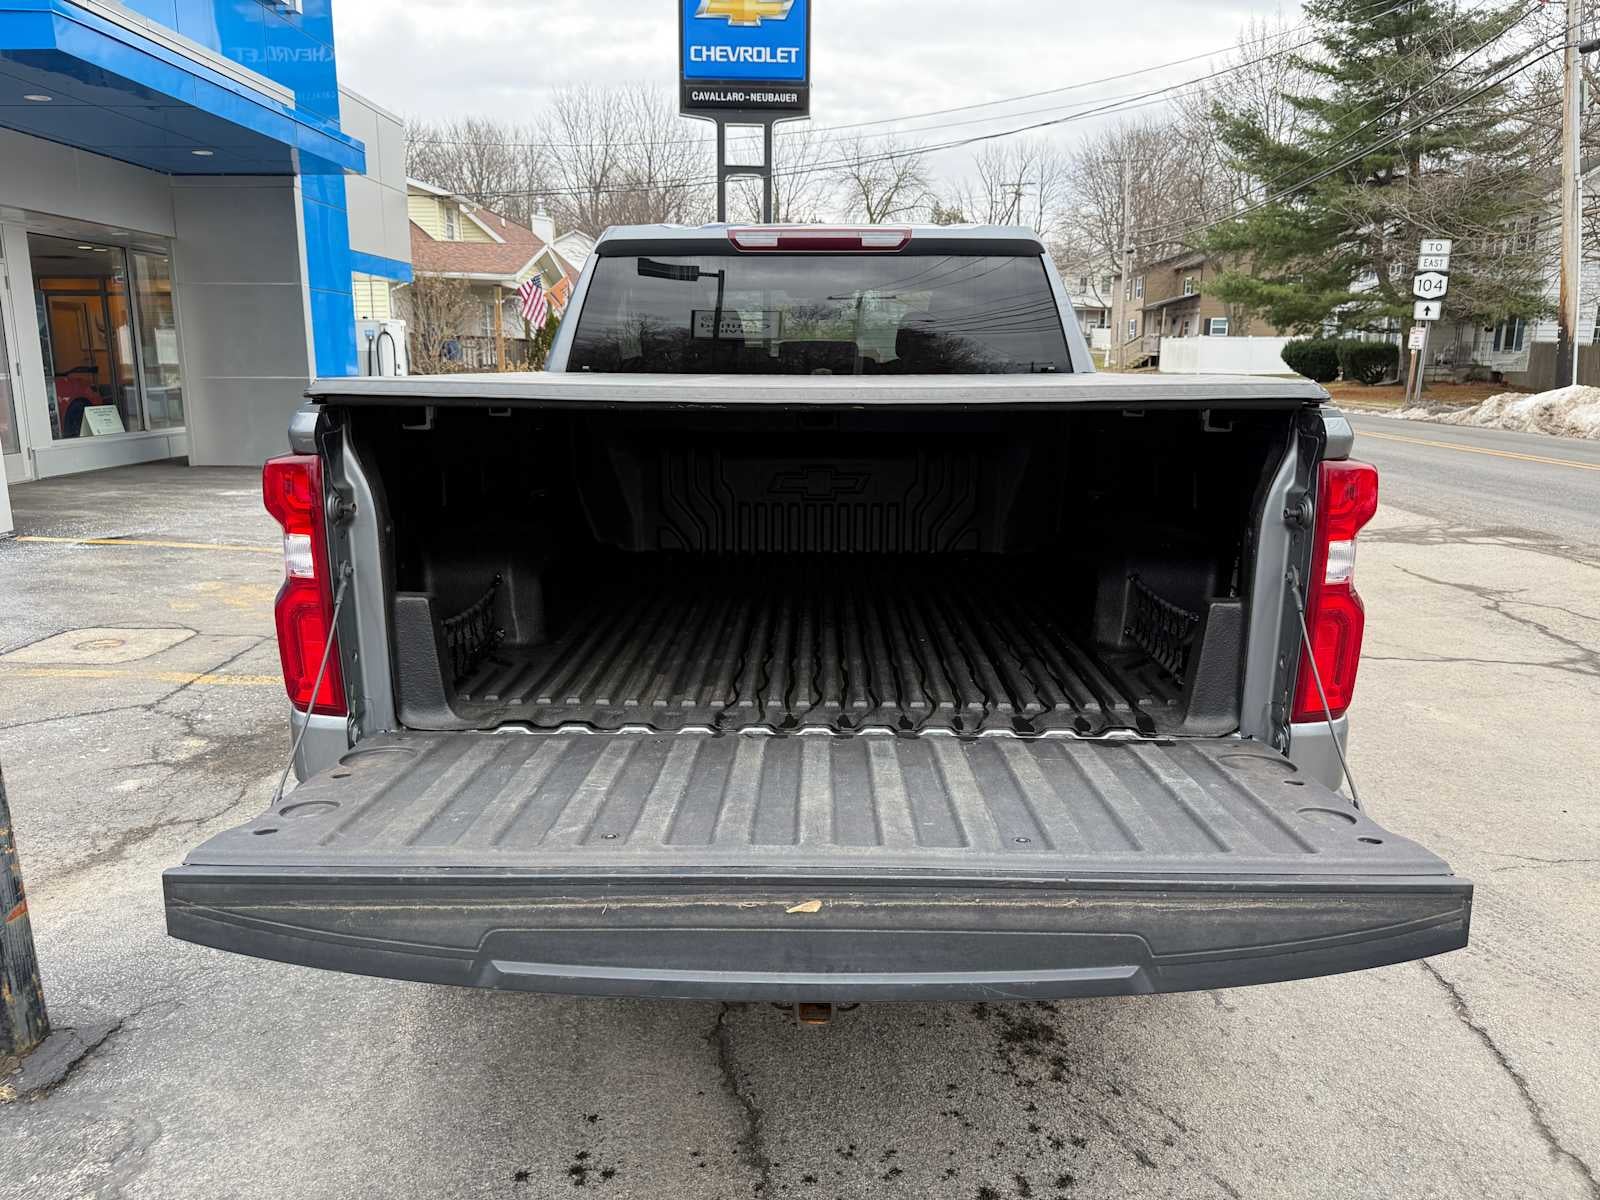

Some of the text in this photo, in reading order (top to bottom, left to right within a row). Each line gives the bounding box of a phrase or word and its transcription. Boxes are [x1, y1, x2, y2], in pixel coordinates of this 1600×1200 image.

[690, 45, 799, 63] CHEVROLET
[692, 91, 798, 103] CAVALLARO-NEUBAUER
[1429, 243, 1443, 252] TO
[1423, 258, 1444, 268] EAST
[1418, 279, 1443, 292] 104
